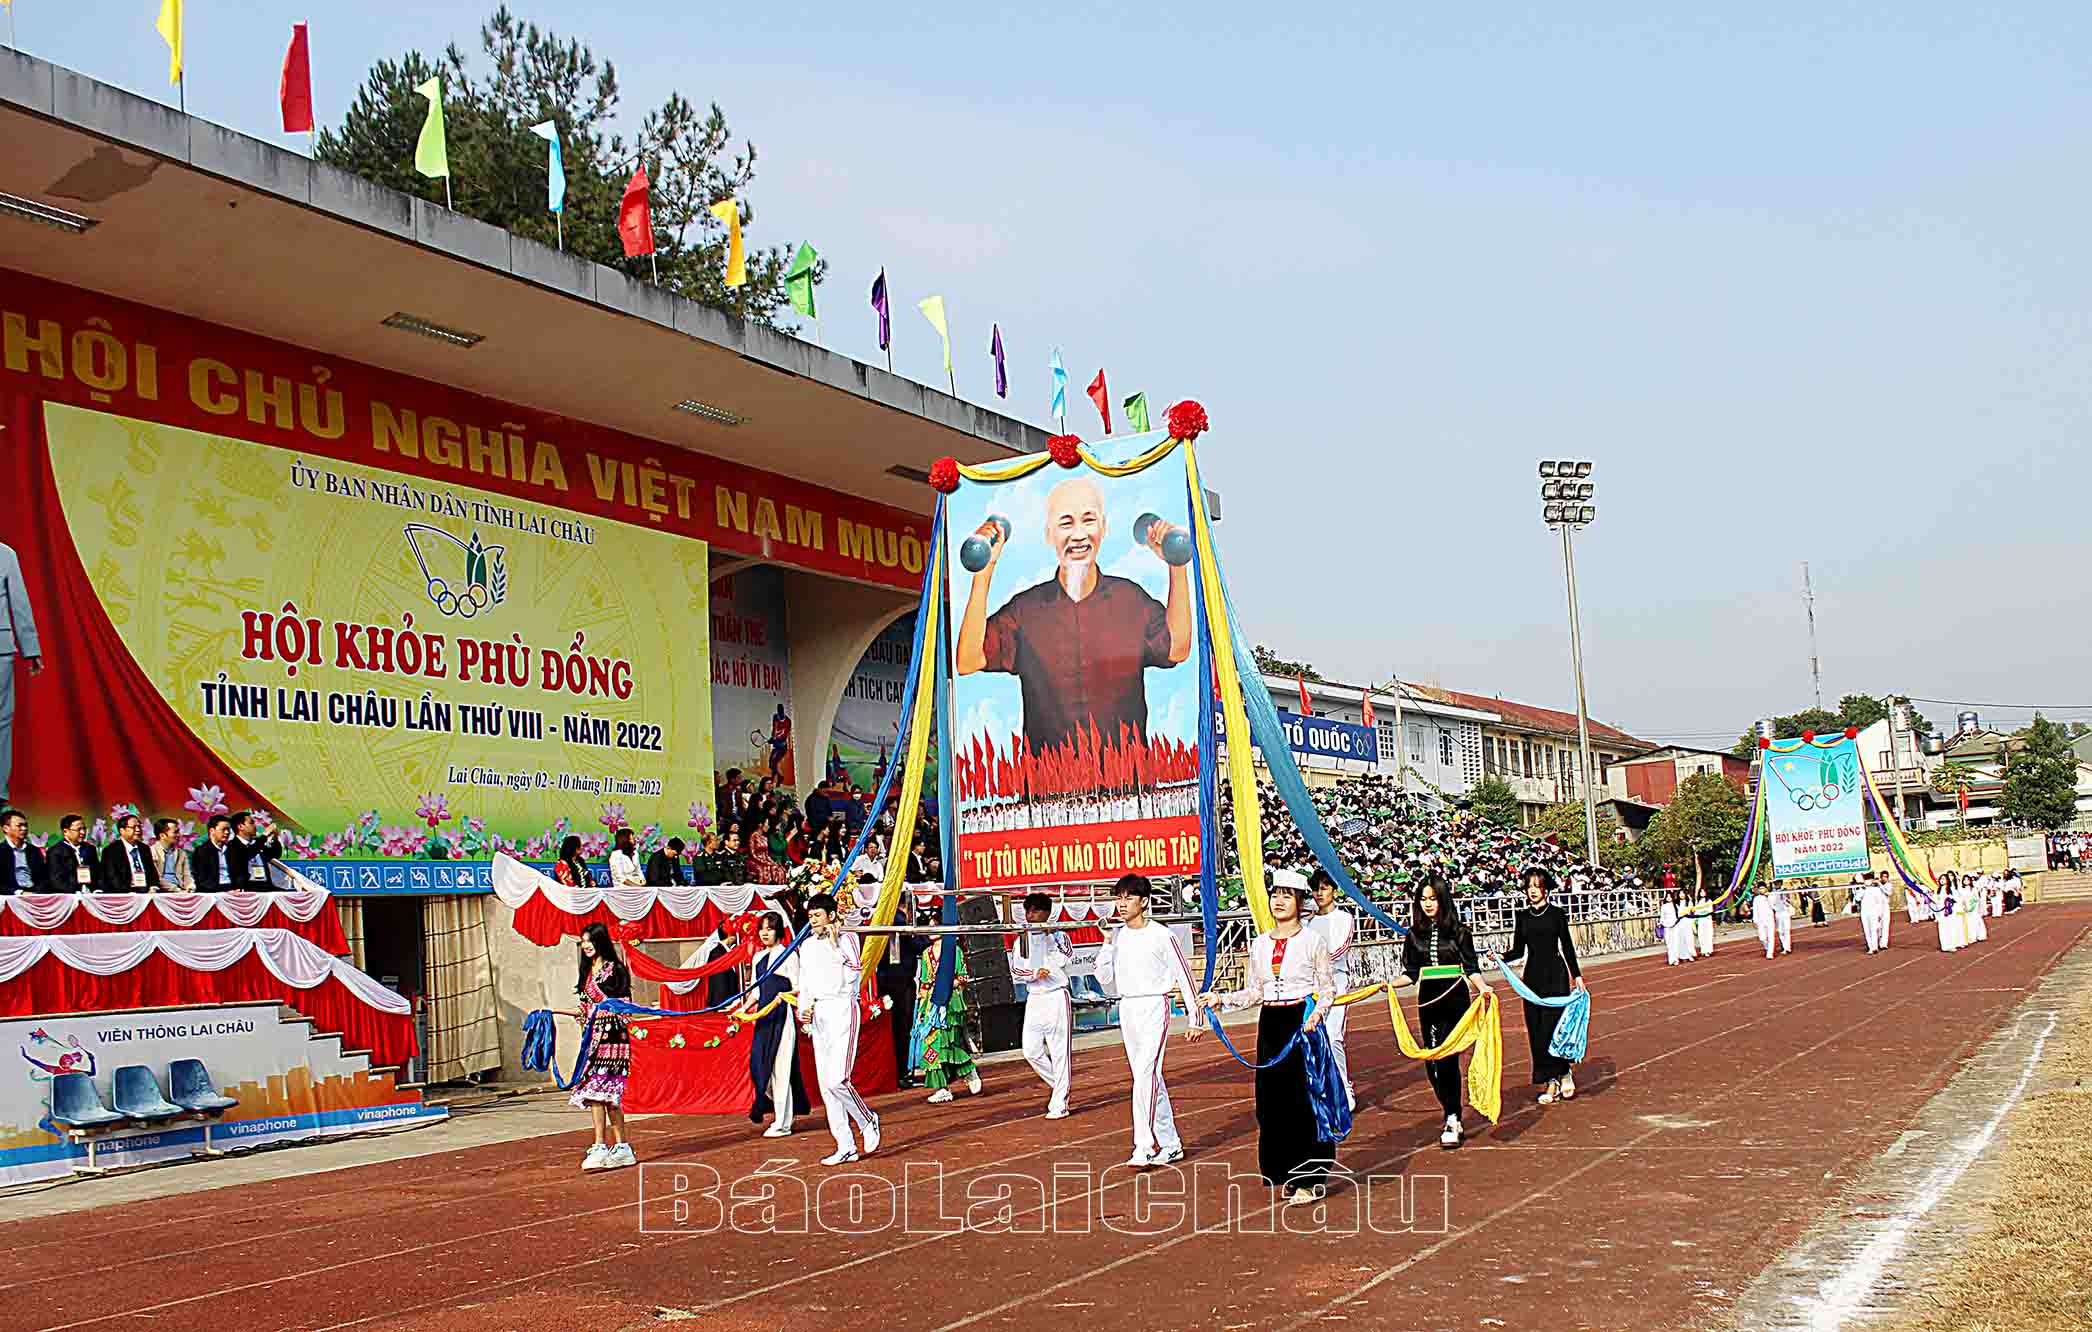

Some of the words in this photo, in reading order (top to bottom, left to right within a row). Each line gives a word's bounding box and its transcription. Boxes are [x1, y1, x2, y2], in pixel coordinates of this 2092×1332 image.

[2, 311, 159, 403] HỘI
[188, 357, 345, 441] CHỦ
[370, 400, 568, 491] NGHĨA
[586, 452, 695, 522] VIỆT
[716, 485, 824, 551] NAM
[290, 460, 320, 489] ỦY
[326, 473, 366, 498] BAN
[371, 482, 425, 511] NHÂN
[431, 491, 468, 520] DÂN
[473, 499, 515, 529] TỈNH
[519, 512, 547, 534] LAI
[551, 519, 596, 545] CHÂU
[241, 601, 322, 677] HỘI
[334, 612, 448, 679] KHỎE
[457, 633, 531, 687] PHÙ
[541, 631, 634, 700] ĐỔNG
[201, 672, 269, 719] TỈNH
[278, 688, 319, 722] LAI
[328, 690, 397, 728] CHÂU
[405, 691, 451, 732] LẦN
[458, 702, 503, 736] THỨ
[507, 709, 543, 740] VIII
[563, 711, 610, 746] NĂM
[616, 722, 662, 751] 2022
[1283, 717, 1303, 746] TỔ
[1309, 724, 1351, 752] QUỐC
[448, 767, 467, 783] Lai
[470, 767, 503, 787] Châu,
[507, 769, 533, 790] ngày
[535, 772, 547, 788] 02
[558, 774, 570, 789] 10
[572, 774, 600, 796] tháng
[604, 777, 612, 793] 11
[616, 778, 637, 794] năm
[640, 780, 661, 795] 2022
[994, 842, 1017, 877] TÔI
[1021, 840, 1058, 875] NGÀY
[1062, 838, 1093, 873] NÀO
[1097, 835, 1120, 870] TÔI
[1124, 834, 1167, 868] CŨNG
[1170, 831, 1199, 871] TẬP
[1820, 842, 1844, 853] 2022
[137, 1024, 187, 1040] THÔNG
[191, 1023, 212, 1036] LAI
[216, 1019, 254, 1034] CHÂU
[230, 1118, 297, 1135] vinaphone
[357, 1105, 416, 1121] vinaphone
[84, 1136, 160, 1152] vnaphone
